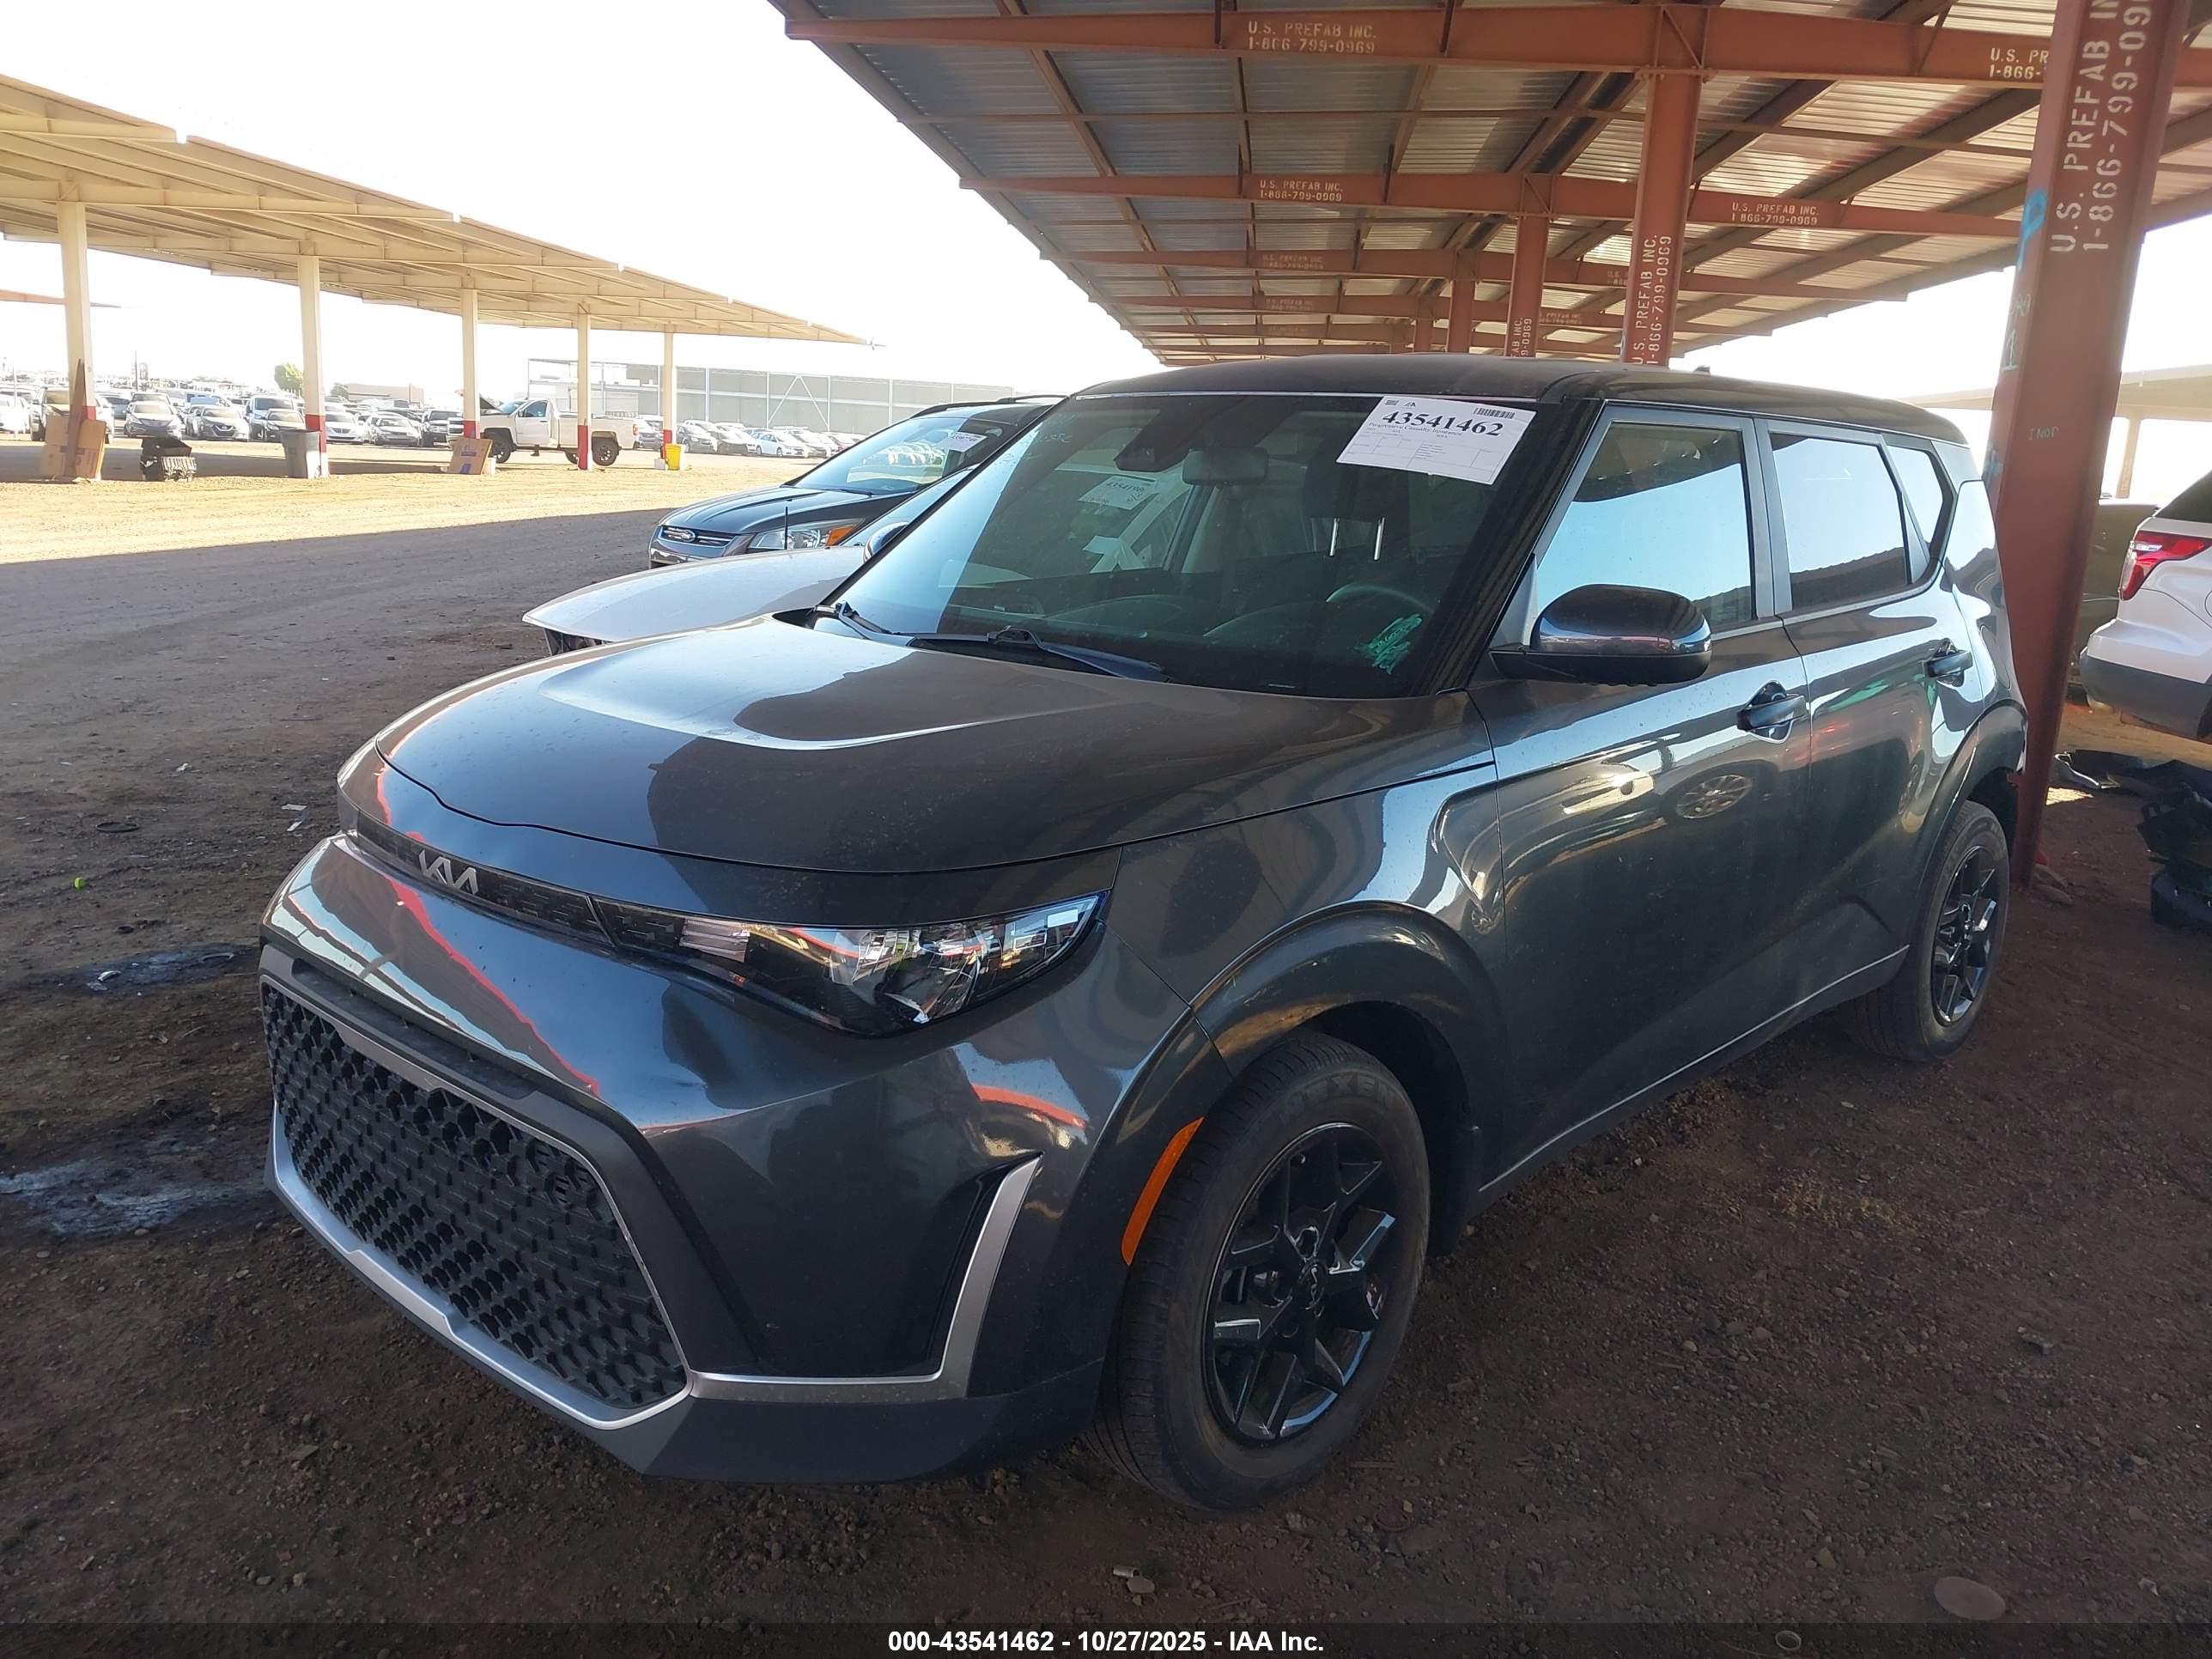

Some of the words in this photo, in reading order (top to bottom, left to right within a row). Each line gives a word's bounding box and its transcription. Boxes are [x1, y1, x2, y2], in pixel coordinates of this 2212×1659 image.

[1248, 20, 1276, 34] U.S.
[1285, 22, 1341, 37] PREFAB
[1348, 25, 1376, 39] INC.
[1990, 47, 2020, 63] U.S.
[1990, 64, 2047, 80] 1-866-
[2063, 40, 2111, 171] PREFAB
[2082, 0, 2151, 252] 1-866-799-09
[1283, 180, 1321, 191] PREFAB
[1756, 204, 1796, 215] PREFAB
[1800, 206, 1819, 216] INC.
[2049, 192, 2084, 252] U.S.
[1642, 234, 1657, 263] INC.
[1635, 270, 1653, 329] PREFAB
[1632, 338, 1647, 365] U.S.
[1382, 410, 1504, 436] 43541462
